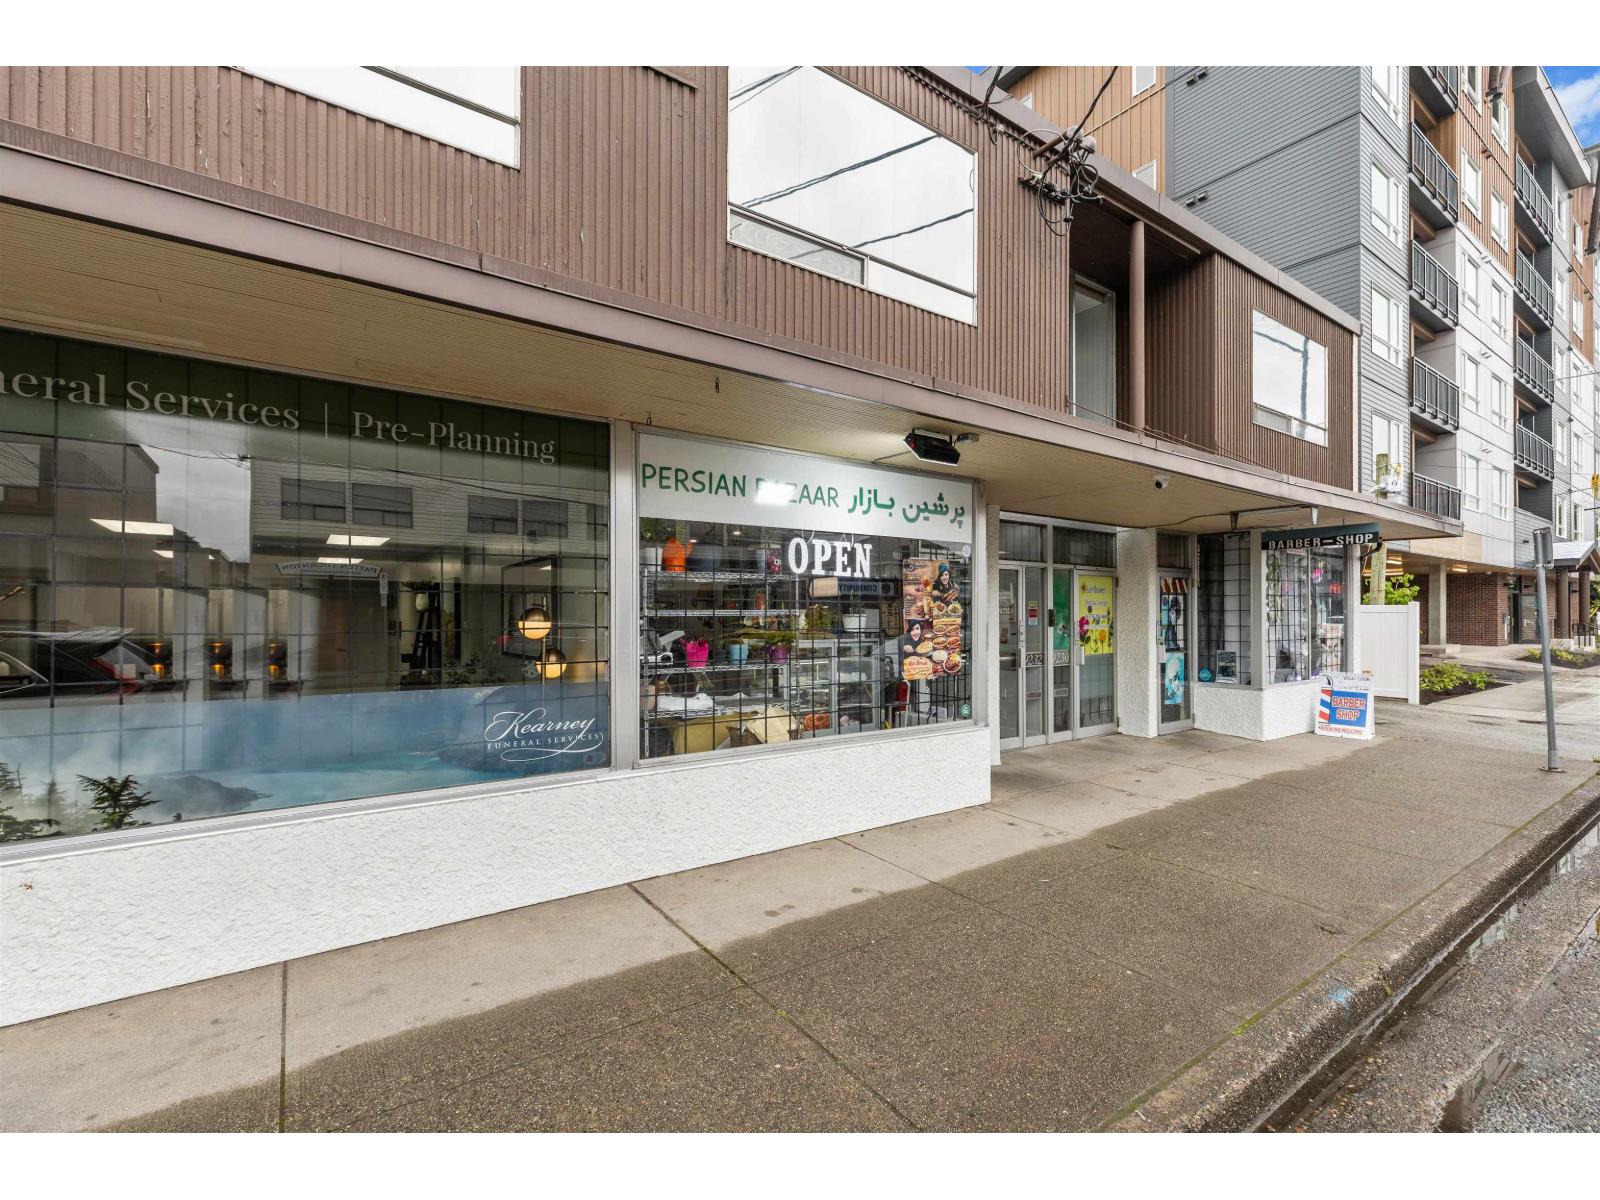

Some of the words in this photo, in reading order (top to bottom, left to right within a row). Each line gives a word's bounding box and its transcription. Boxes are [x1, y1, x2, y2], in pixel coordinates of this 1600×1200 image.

[126, 380, 300, 430] Services
[352, 411, 555, 464] Pre-Planning
[641, 463, 747, 497] PERSIAN
[755, 477, 840, 508] AAR
[847, 486, 895, 518] بازار
[902, 492, 965, 528] پرشین
[787, 536, 873, 579] OPEN
[1332, 696, 1366, 709] BARBER
[1336, 708, 1360, 720] SHOP
[484, 707, 600, 750] Kearney
[487, 738, 541, 750] FUNERAL
[547, 733, 600, 745] SERVICES
